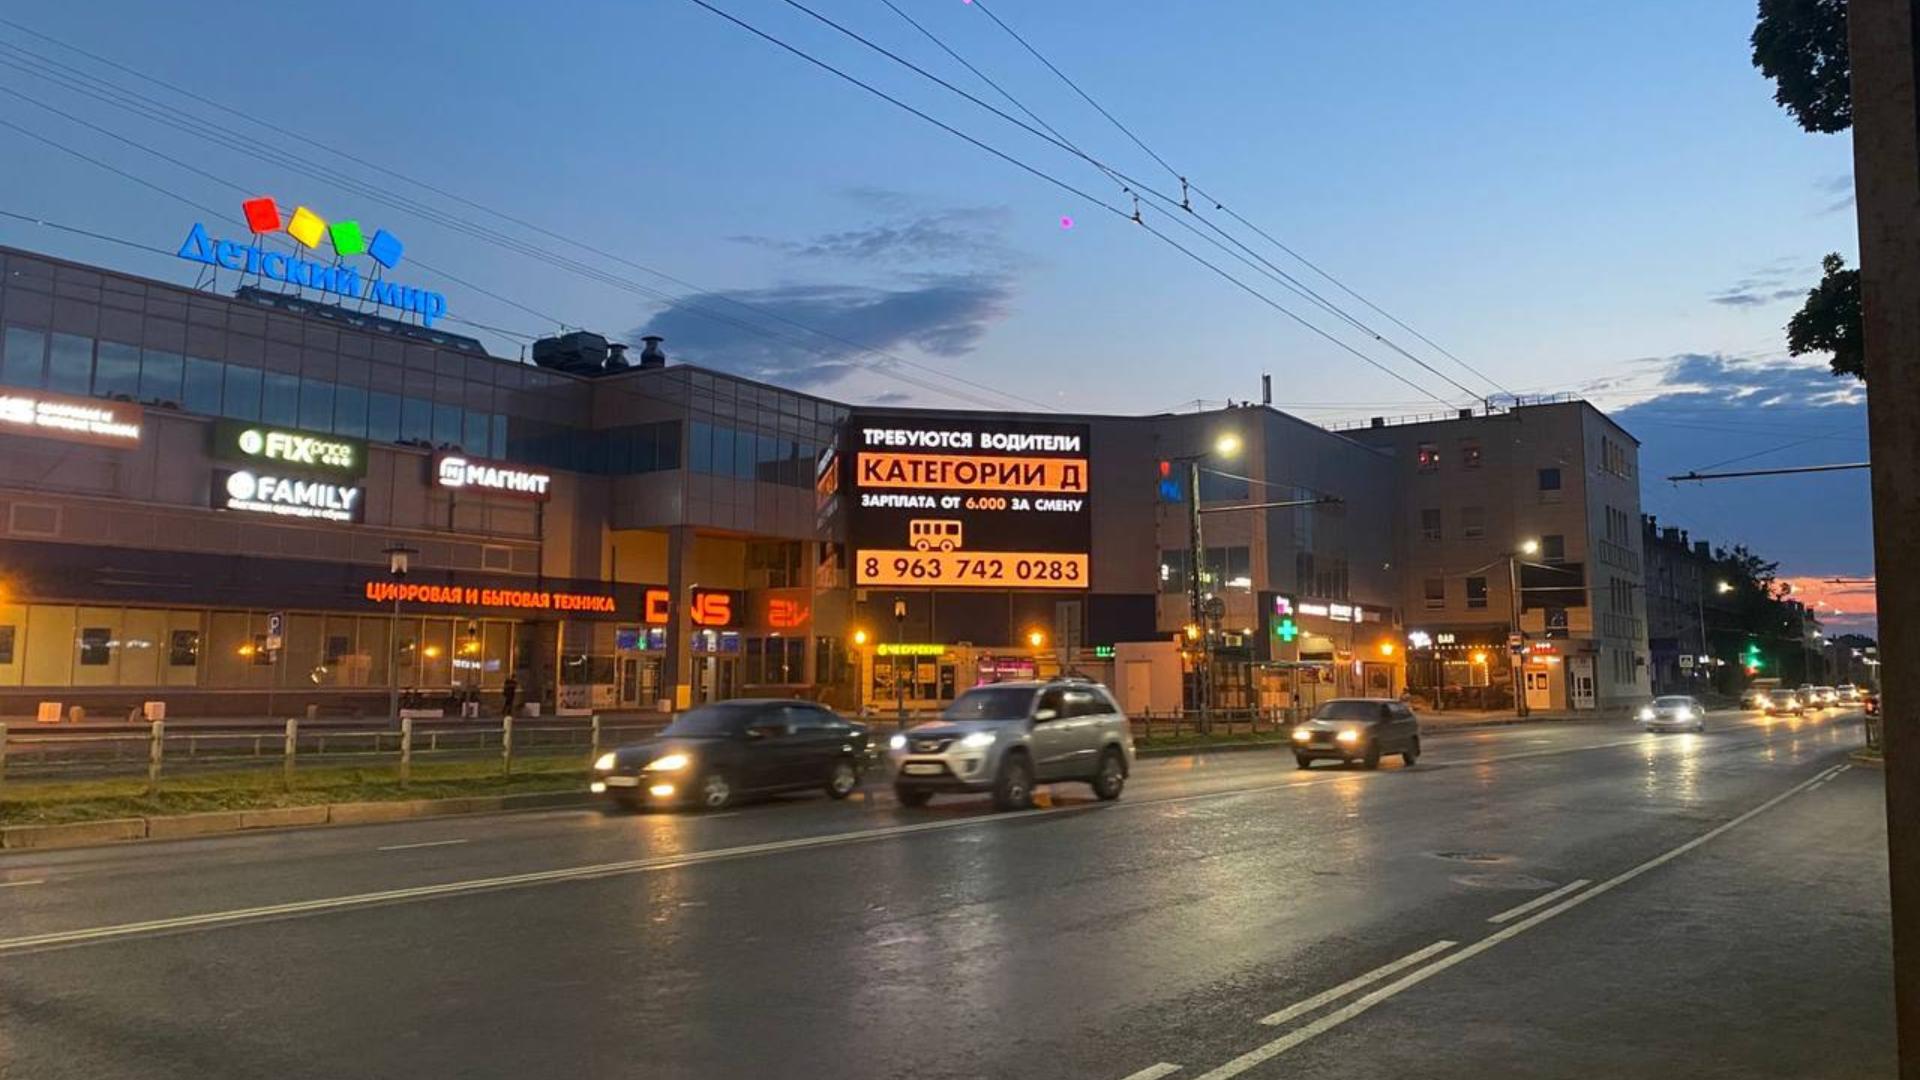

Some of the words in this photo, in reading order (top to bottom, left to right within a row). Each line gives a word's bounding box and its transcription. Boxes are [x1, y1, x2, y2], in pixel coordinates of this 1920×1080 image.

[178, 222, 362, 298] Детский
[371, 278, 447, 327] мир
[265, 431, 314, 463] FIX
[863, 428, 973, 448] ТРЕБУЮТСЯ
[980, 433, 1081, 452] ВОДИТЕЛИ
[466, 465, 550, 493] МАГНИТ
[864, 458, 1046, 486] КАТЕГОРИИ
[1060, 464, 1081, 490] Д
[257, 476, 358, 510] FAMILY
[861, 494, 935, 509] ЗАРПЛАТА
[941, 496, 961, 509] ОТ
[965, 496, 1006, 510] 6.000
[1011, 498, 1030, 511] ЗА
[1034, 498, 1082, 512] СМЕНУ
[865, 557, 879, 577] 8
[893, 558, 942, 578] 963
[956, 559, 1003, 579] 742
[1016, 560, 1079, 580] 0283
[366, 582, 461, 604] ЦИФРОВАЯ
[465, 588, 478, 604] И
[481, 589, 550, 608] БЫТОВАЯ
[553, 594, 615, 612] ТЕХНИКА
